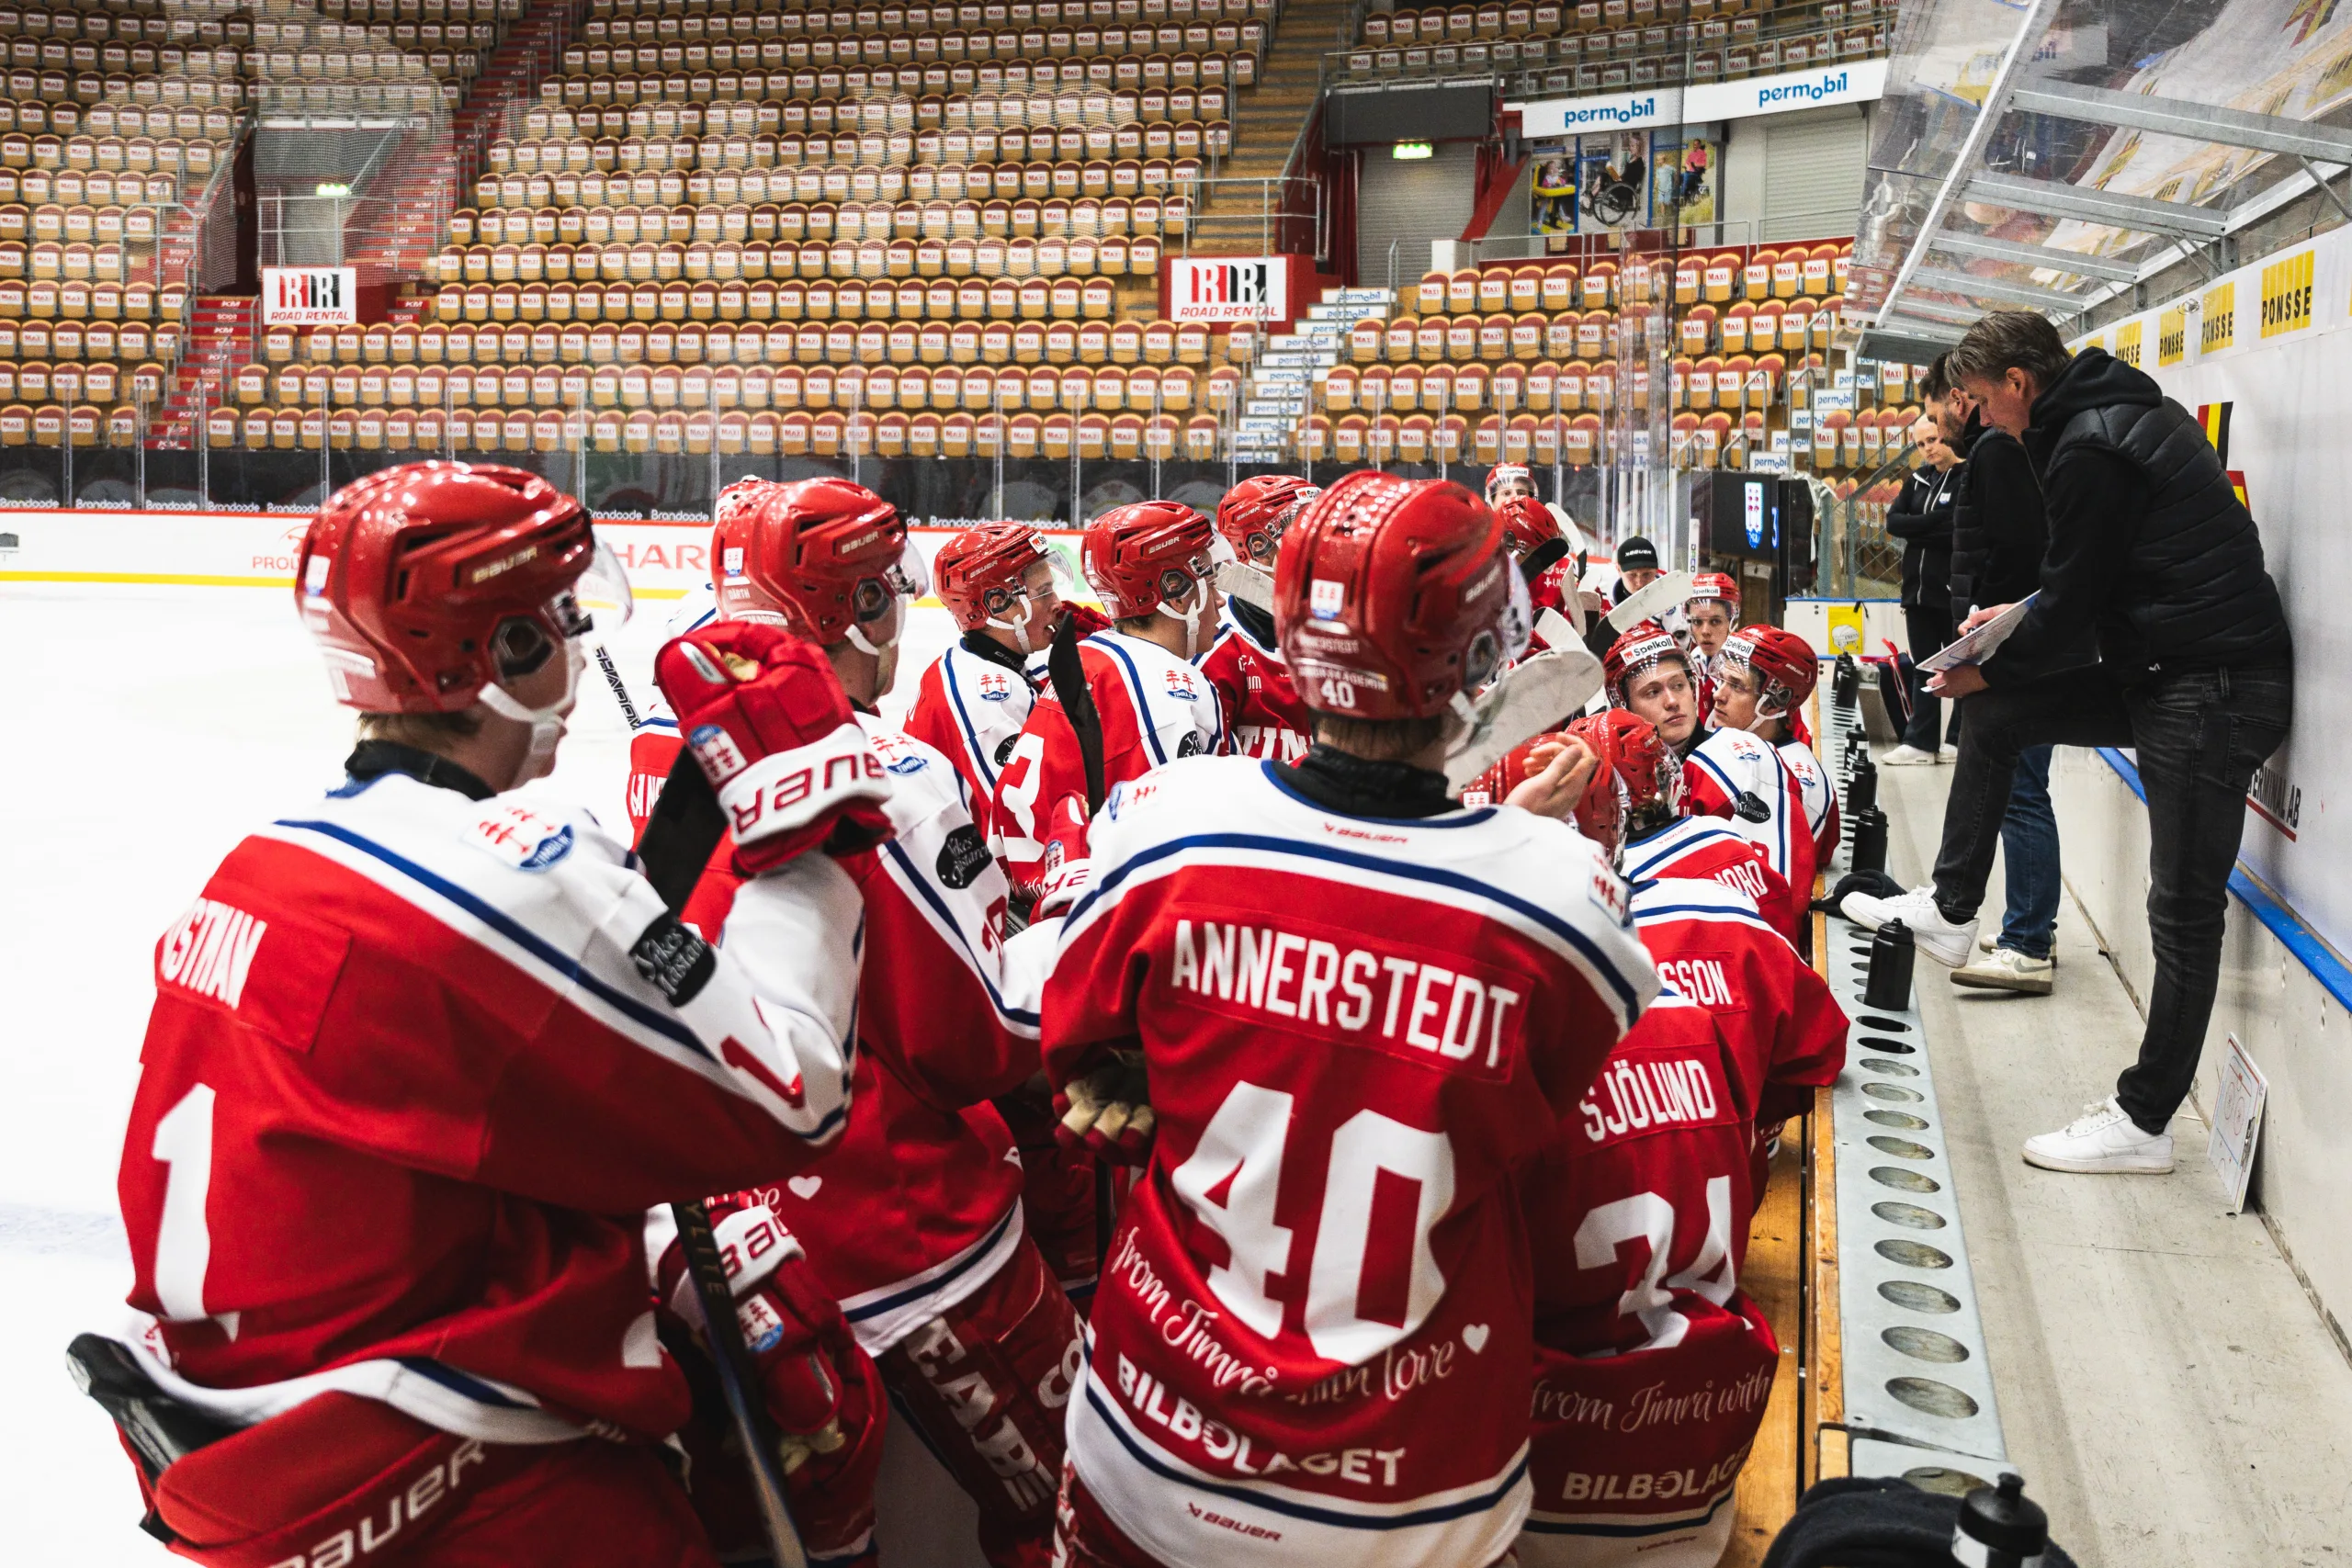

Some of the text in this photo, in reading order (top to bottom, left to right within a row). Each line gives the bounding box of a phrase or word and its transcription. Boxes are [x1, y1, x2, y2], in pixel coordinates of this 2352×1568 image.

[1758, 72, 1848, 108] permobil
[1564, 97, 1655, 129] permobil
[271, 311, 349, 321] ROAD RENTAL
[1180, 306, 1278, 318] ROAD RENTAL
[2262, 286, 2312, 328] PONSSE
[2202, 311, 2233, 346] PONSSE
[2159, 331, 2184, 359] PONSSE
[842, 531, 879, 555] BAUER
[1148, 536, 1181, 555] BAUER
[969, 559, 1000, 579] BAUER
[1692, 586, 1720, 596] Spelkoll
[1634, 637, 1673, 658] Spelkoll
[1725, 637, 1753, 655] Spelkoll
[1321, 680, 1356, 708] 40
[2286, 784, 2301, 829] AB
[1171, 919, 1521, 1069] ANNERSTEDT
[1578, 1058, 1718, 1144] SJÖLUND
[153, 1081, 216, 1322] 1
[1171, 1079, 1456, 1366] 40
[1111, 1225, 1170, 1325] from
[1162, 1298, 1279, 1397] Timrå
[1382, 1339, 1455, 1402] love
[1529, 1362, 1772, 1434] from Timrå with
[1117, 1350, 1407, 1486] BILBOLAGET
[1202, 1511, 1283, 1542] BAUER
